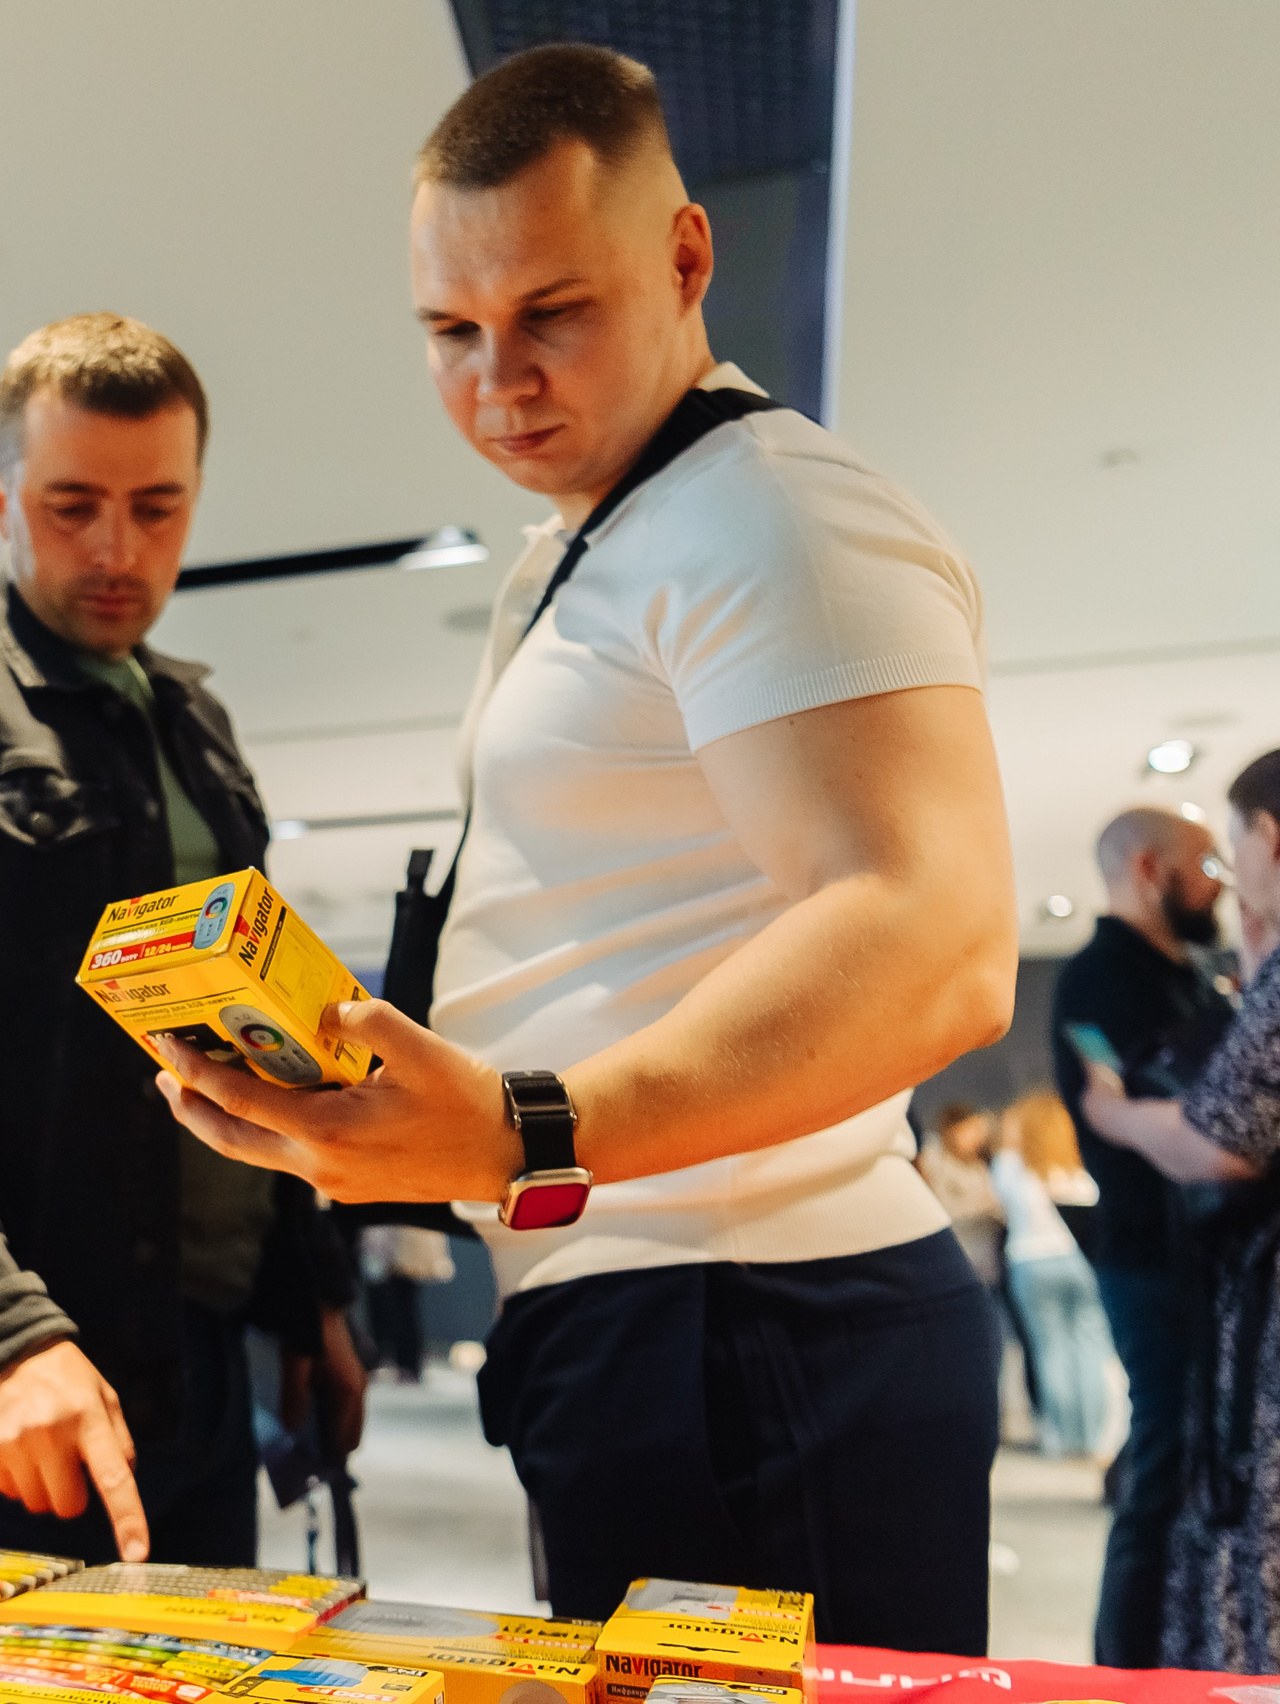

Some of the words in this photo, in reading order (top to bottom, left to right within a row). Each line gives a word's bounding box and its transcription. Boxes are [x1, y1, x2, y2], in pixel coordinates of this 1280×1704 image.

[107, 895, 179, 923] Navigator
[238, 887, 275, 967] Navigator
[91, 949, 122, 969] 360
[94, 983, 171, 1004] Navigator
[606, 1655, 703, 1679] Navigator
